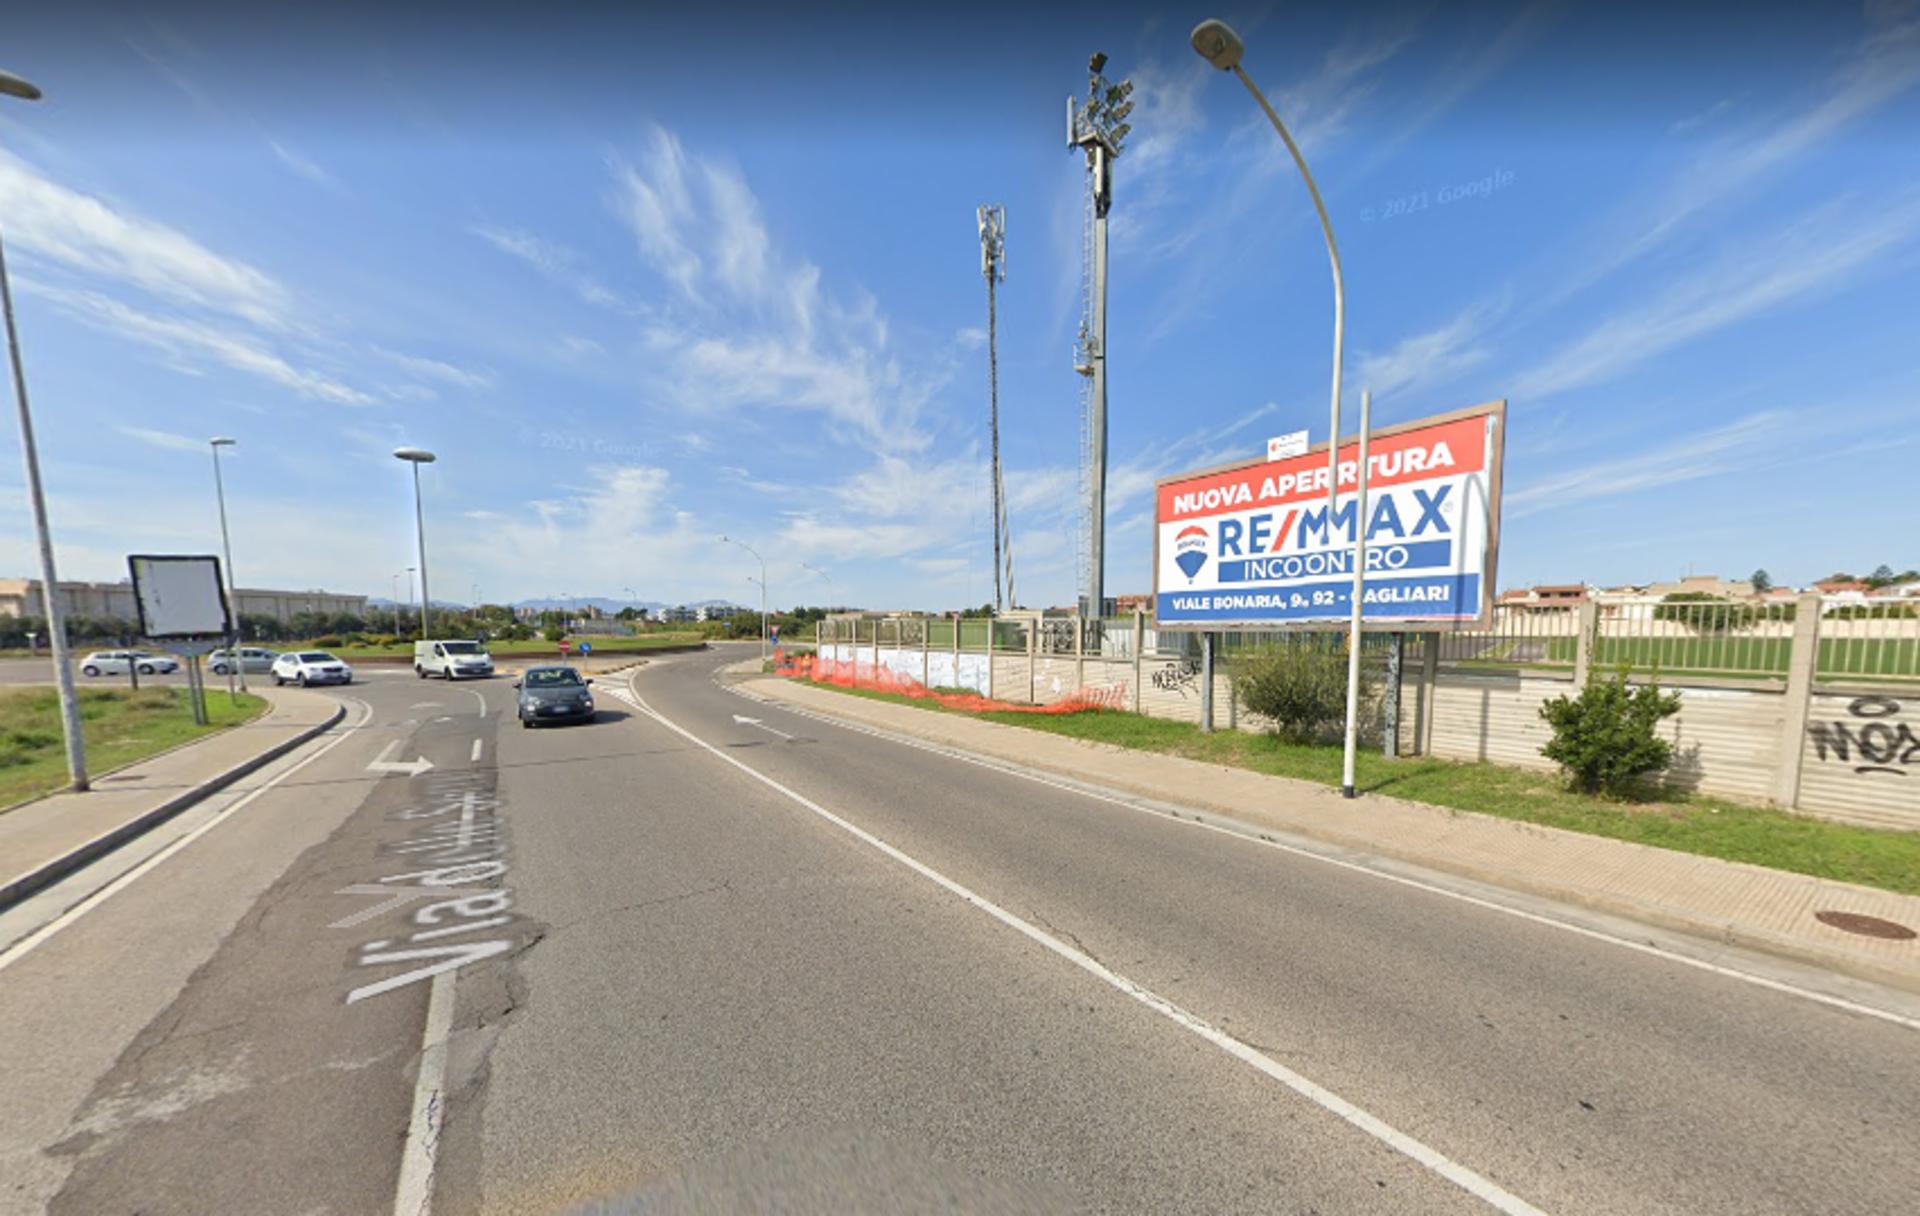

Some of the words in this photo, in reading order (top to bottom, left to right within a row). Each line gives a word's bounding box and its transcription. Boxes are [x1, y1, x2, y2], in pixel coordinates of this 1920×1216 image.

[1174, 483, 1254, 516] NUOVA
[1172, 596, 1210, 611] VIALE
[1312, 589, 1335, 606] 92
